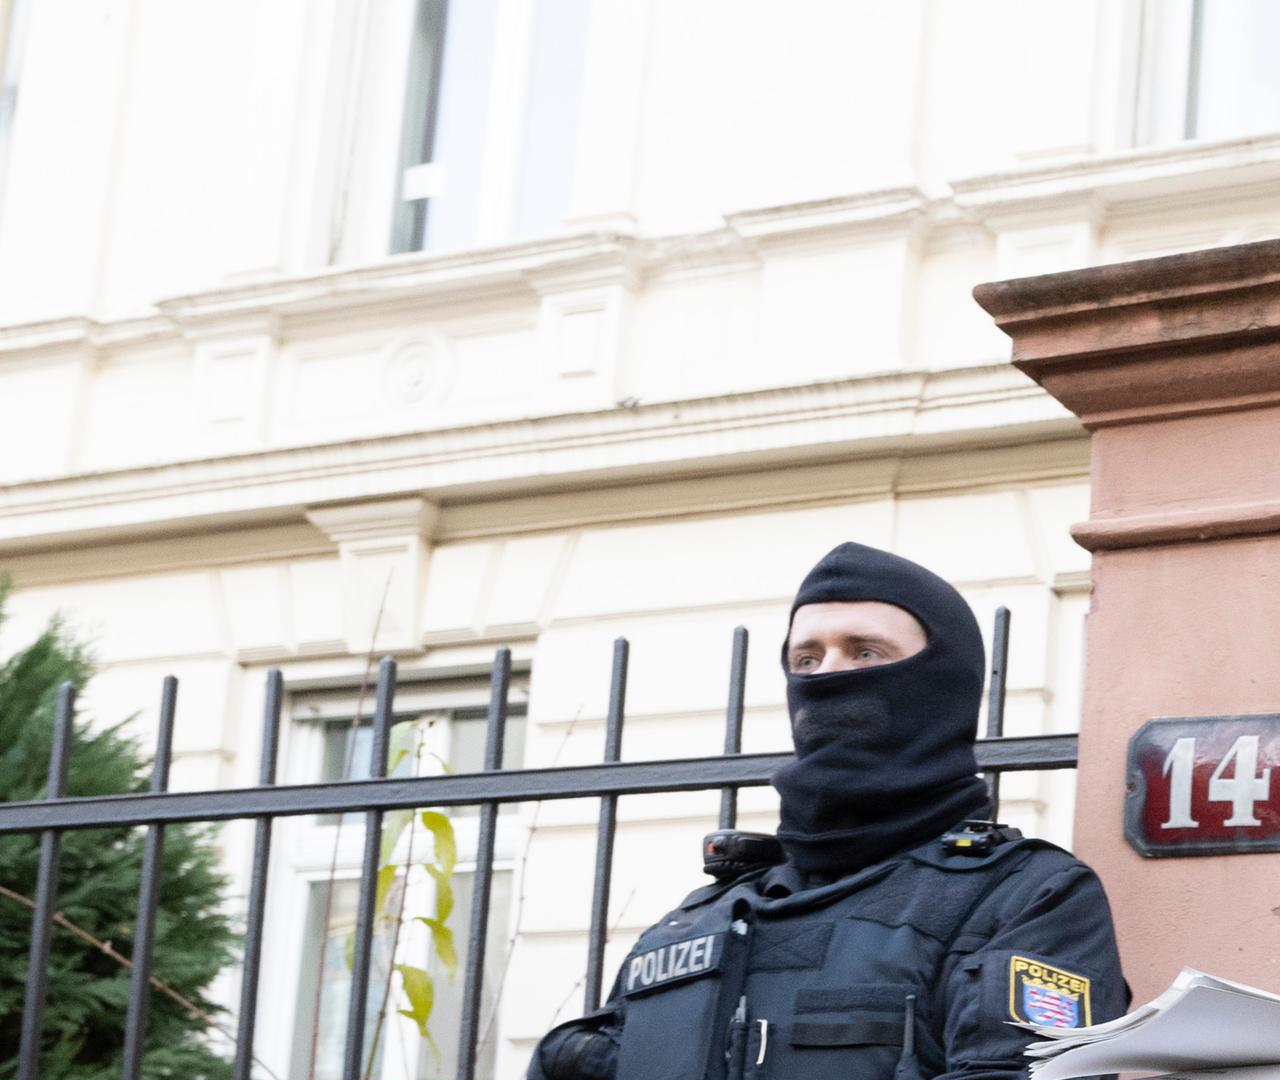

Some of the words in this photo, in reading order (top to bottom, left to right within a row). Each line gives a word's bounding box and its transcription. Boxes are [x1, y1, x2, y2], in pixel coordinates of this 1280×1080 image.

[1160, 735, 1272, 829] 14
[627, 935, 715, 991] POLIZEI
[1015, 961, 1086, 993] POLIZEI
